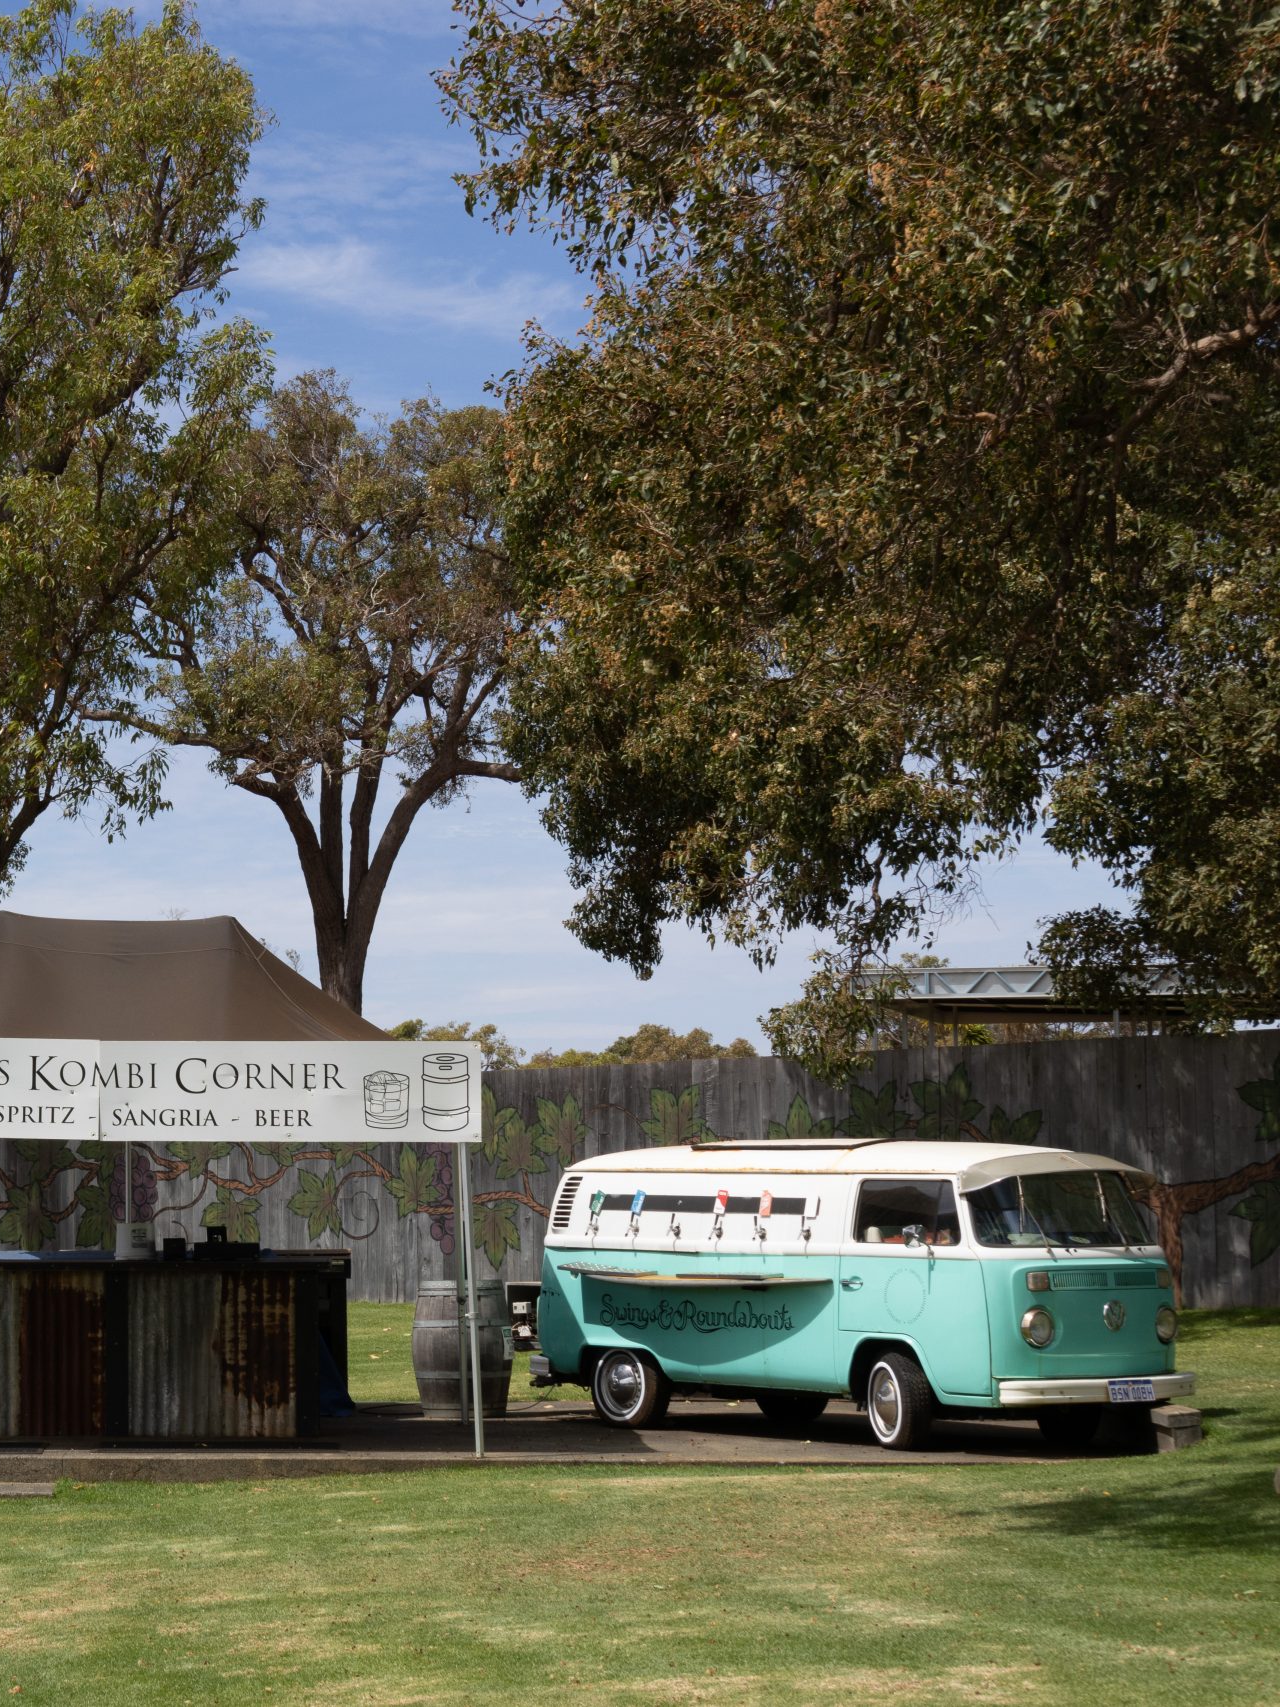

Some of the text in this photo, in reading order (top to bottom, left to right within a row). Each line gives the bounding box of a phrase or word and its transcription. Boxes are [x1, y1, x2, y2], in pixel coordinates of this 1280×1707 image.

[112, 1108, 220, 1127] SANGRIA
[255, 1109, 313, 1127] BEER
[600, 1294, 659, 1330] Swings
[673, 1299, 795, 1333] Roundabouts
